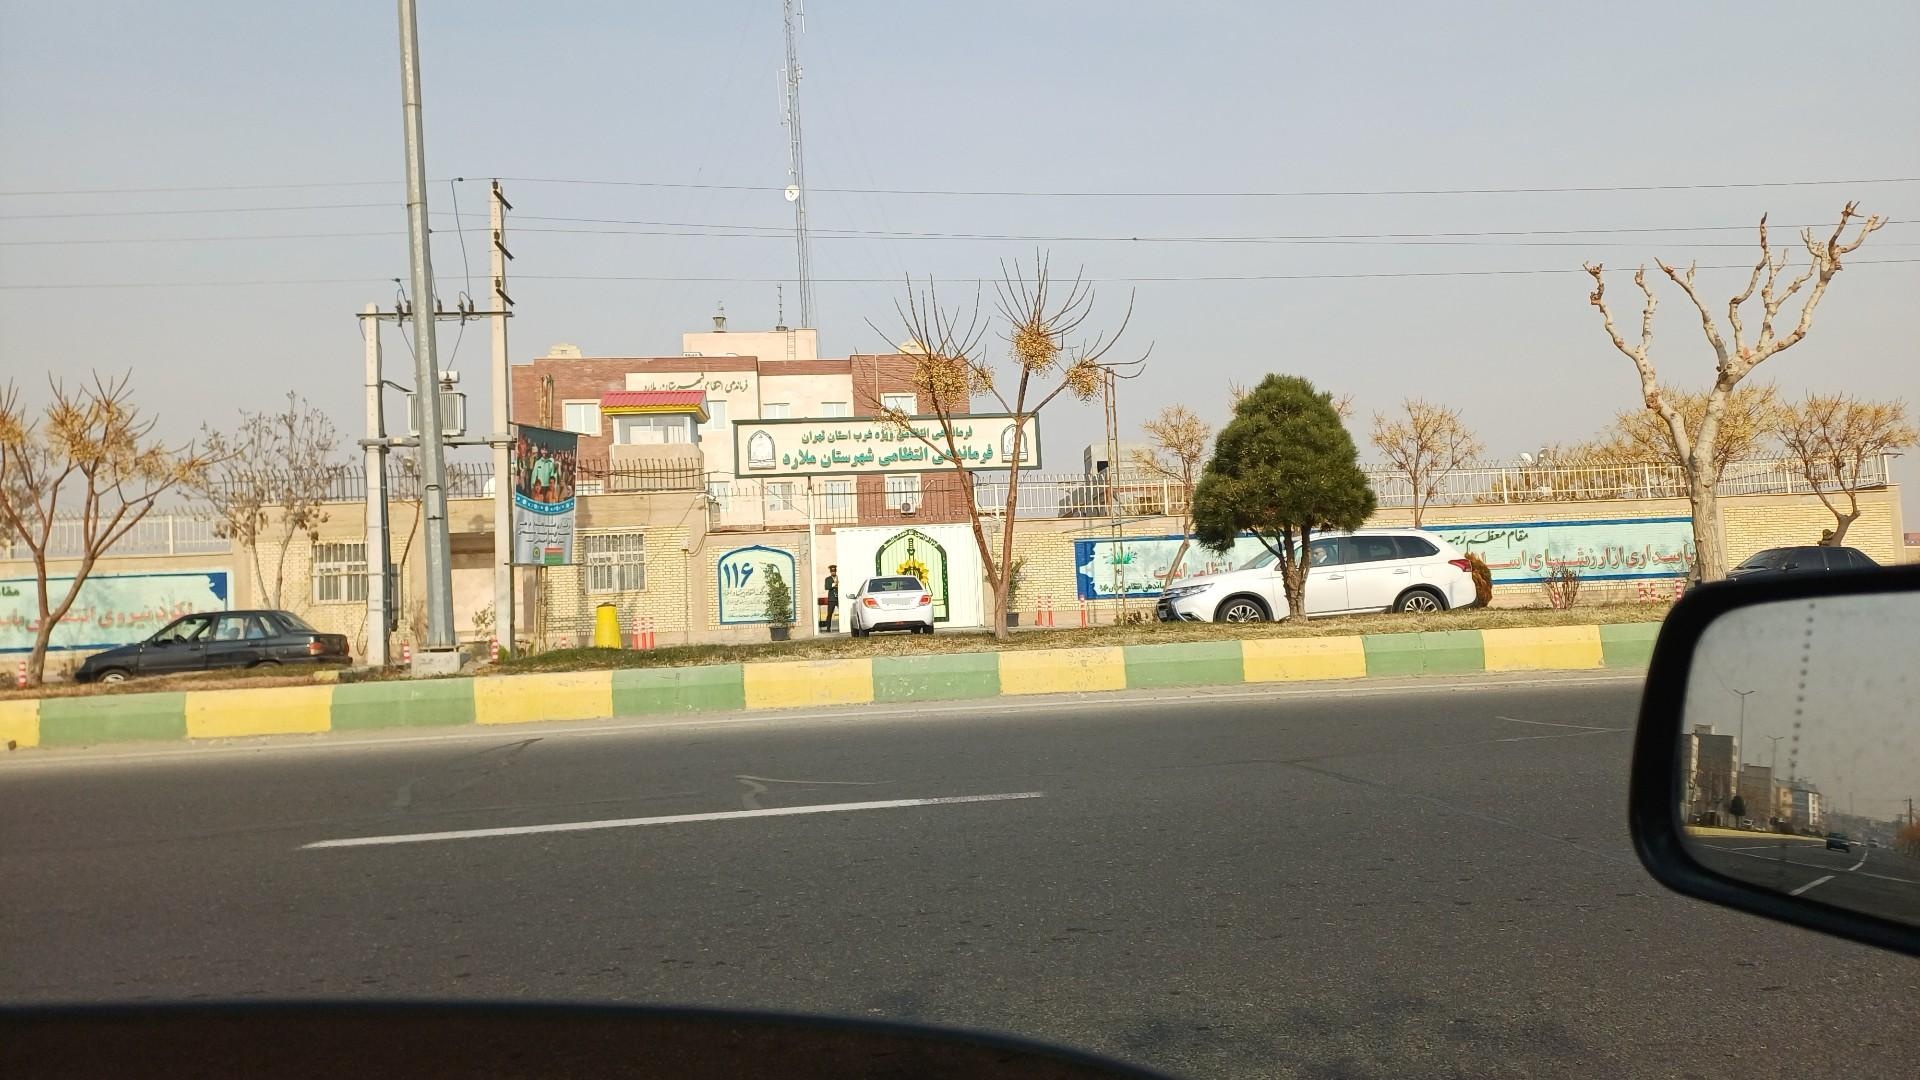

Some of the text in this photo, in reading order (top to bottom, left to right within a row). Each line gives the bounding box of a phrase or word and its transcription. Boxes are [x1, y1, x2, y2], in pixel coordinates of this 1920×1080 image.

[801, 429, 825, 444] تهران
[827, 429, 852, 444] استان
[853, 428, 873, 443] غرب
[782, 449, 817, 470] ملارد
[820, 447, 875, 468] شهرستان
[879, 445, 928, 467] انتظامی
[1507, 528, 1529, 549] مقام
[1611, 544, 1625, 569] از
[723, 562, 754, 589] ۱۱۶
